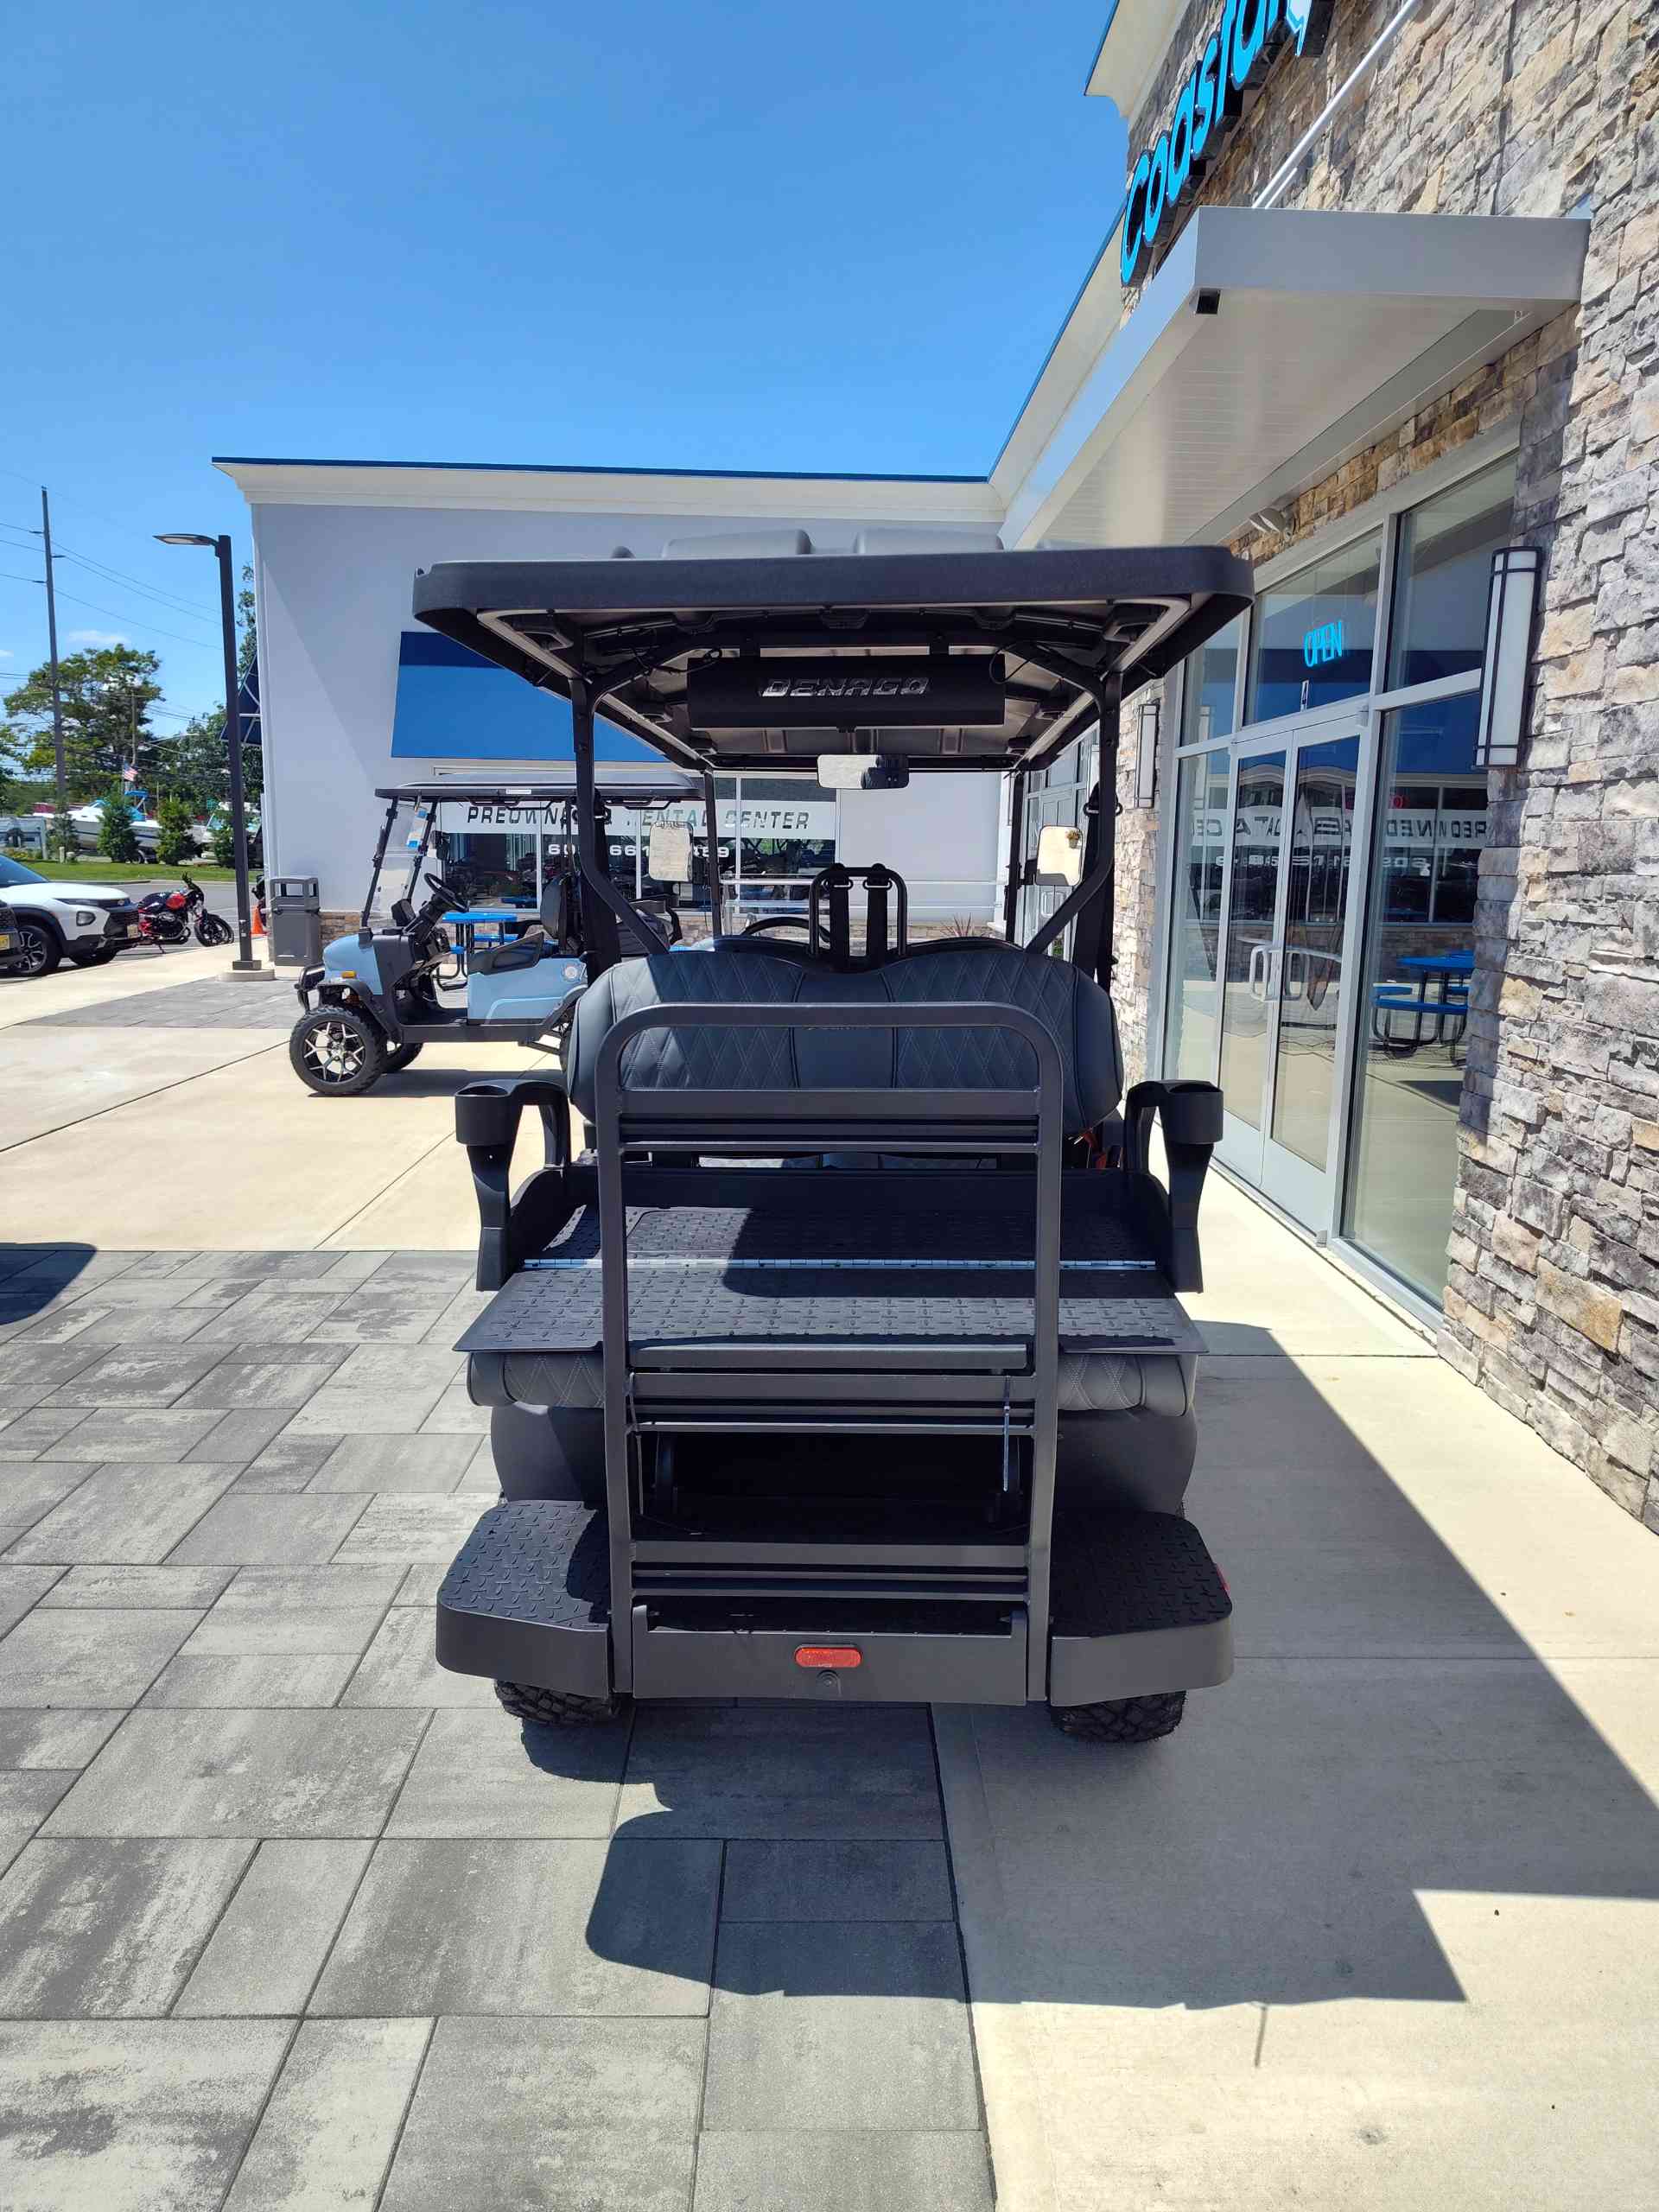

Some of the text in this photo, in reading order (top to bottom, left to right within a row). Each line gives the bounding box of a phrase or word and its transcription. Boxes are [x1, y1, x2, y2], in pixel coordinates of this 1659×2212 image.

[1121, 0, 1279, 286] Coasta
[1304, 620, 1342, 667] OPEN
[761, 678, 931, 697] DENAGO
[467, 806, 578, 825] PREOWN
[725, 810, 809, 830] CENTER
